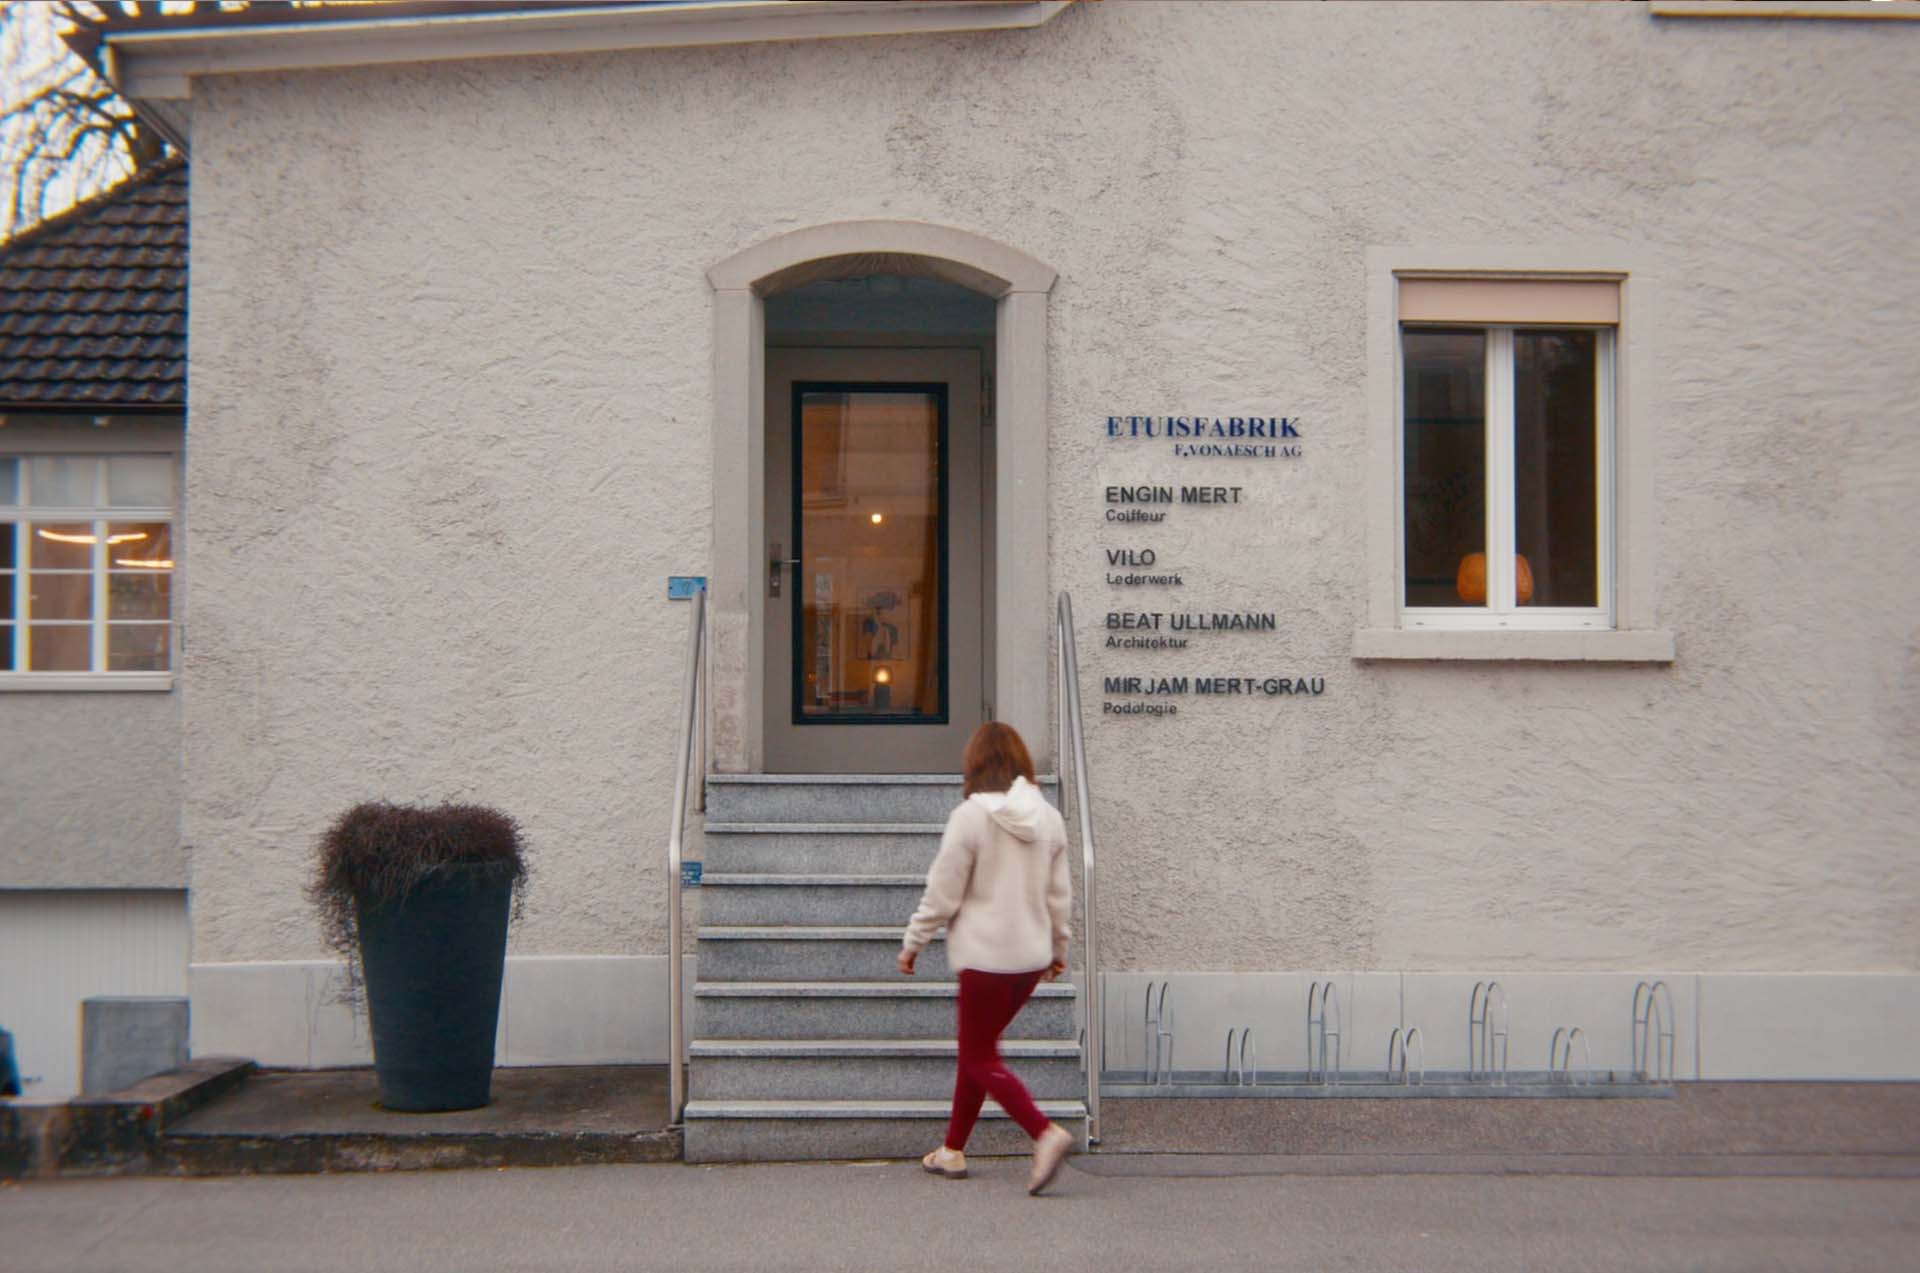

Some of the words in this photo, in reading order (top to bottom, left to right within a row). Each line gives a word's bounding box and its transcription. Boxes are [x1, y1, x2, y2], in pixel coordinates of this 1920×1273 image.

[1106, 415, 1301, 437] ETUISFABRIK
[1280, 445, 1303, 458] AG
[1106, 486, 1173, 504] ENGIN
[1181, 487, 1243, 504] MERT
[1105, 509, 1166, 523] Coiffeur
[1106, 548, 1156, 567] VILO
[1106, 572, 1182, 586] Lederwerk
[1106, 612, 1163, 630] BEAT
[1170, 613, 1276, 631] ULLMANN
[1105, 635, 1188, 649] Architektur
[1195, 677, 1325, 695] MERT-GRAU
[1102, 702, 1178, 717] Podologie
